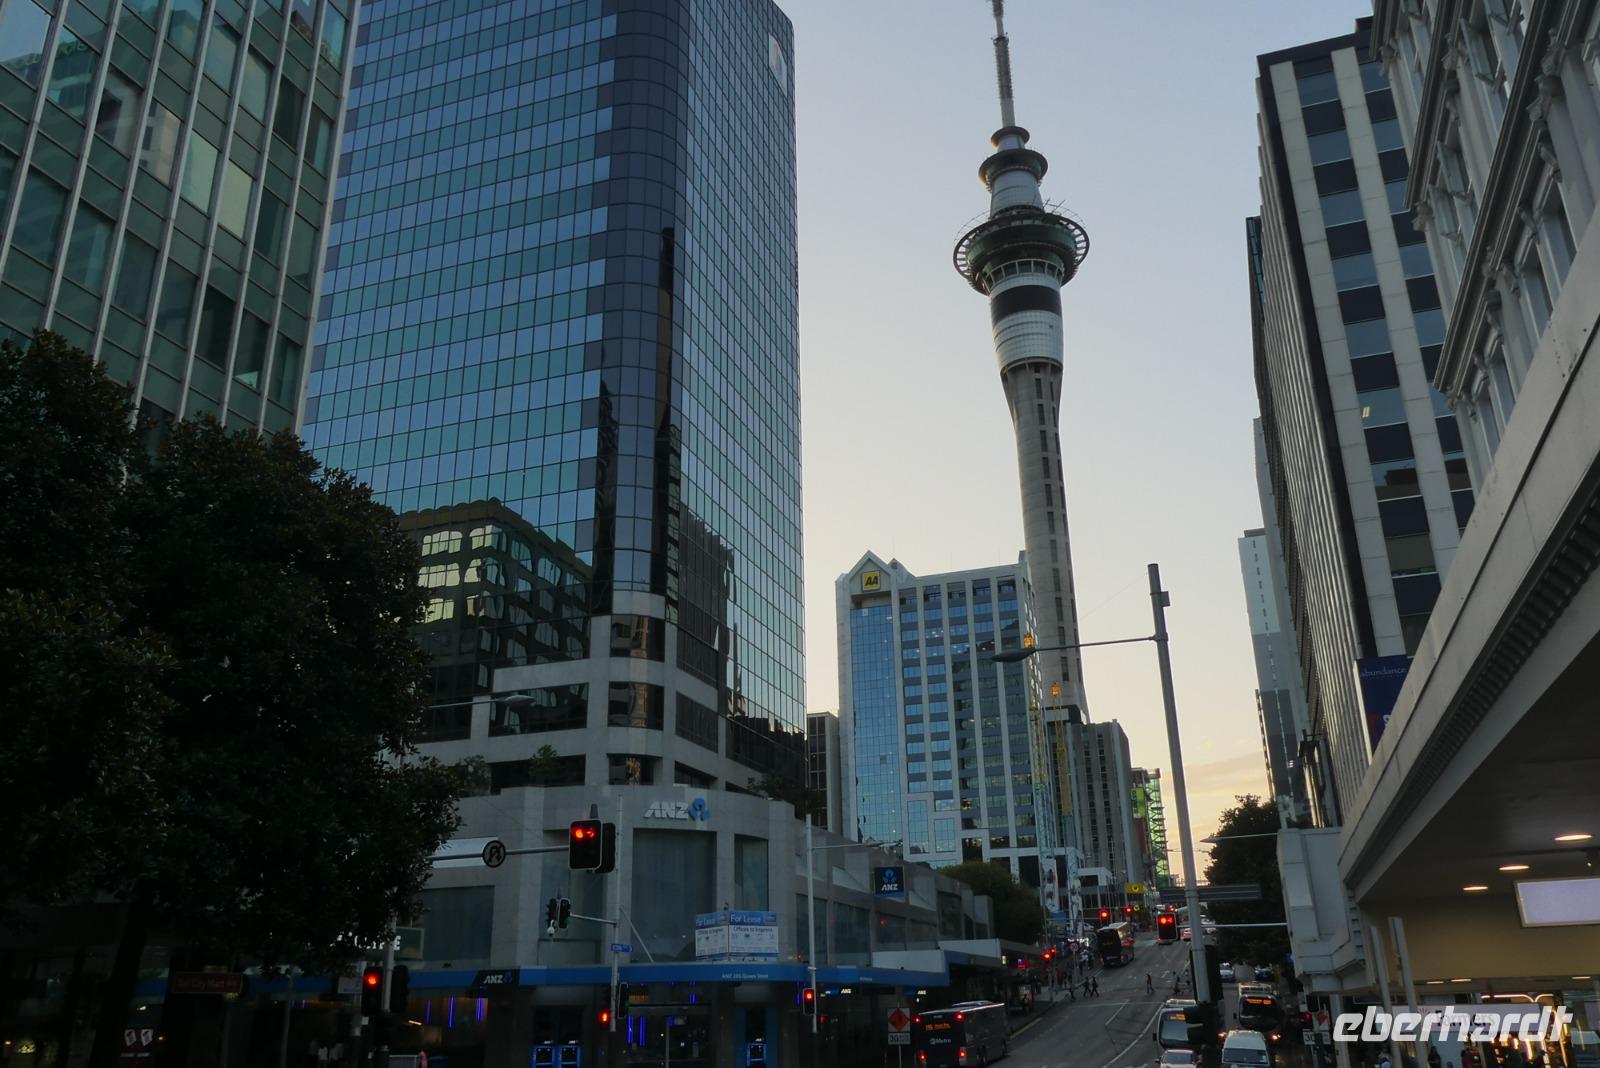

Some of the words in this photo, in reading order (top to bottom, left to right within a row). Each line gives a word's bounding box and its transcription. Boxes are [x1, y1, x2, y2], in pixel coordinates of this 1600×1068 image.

[865, 575, 878, 586] AA
[644, 801, 689, 819] ANZ
[881, 883, 899, 892] ANZ
[730, 914, 741, 923] For
[483, 974, 504, 985] ANZ
